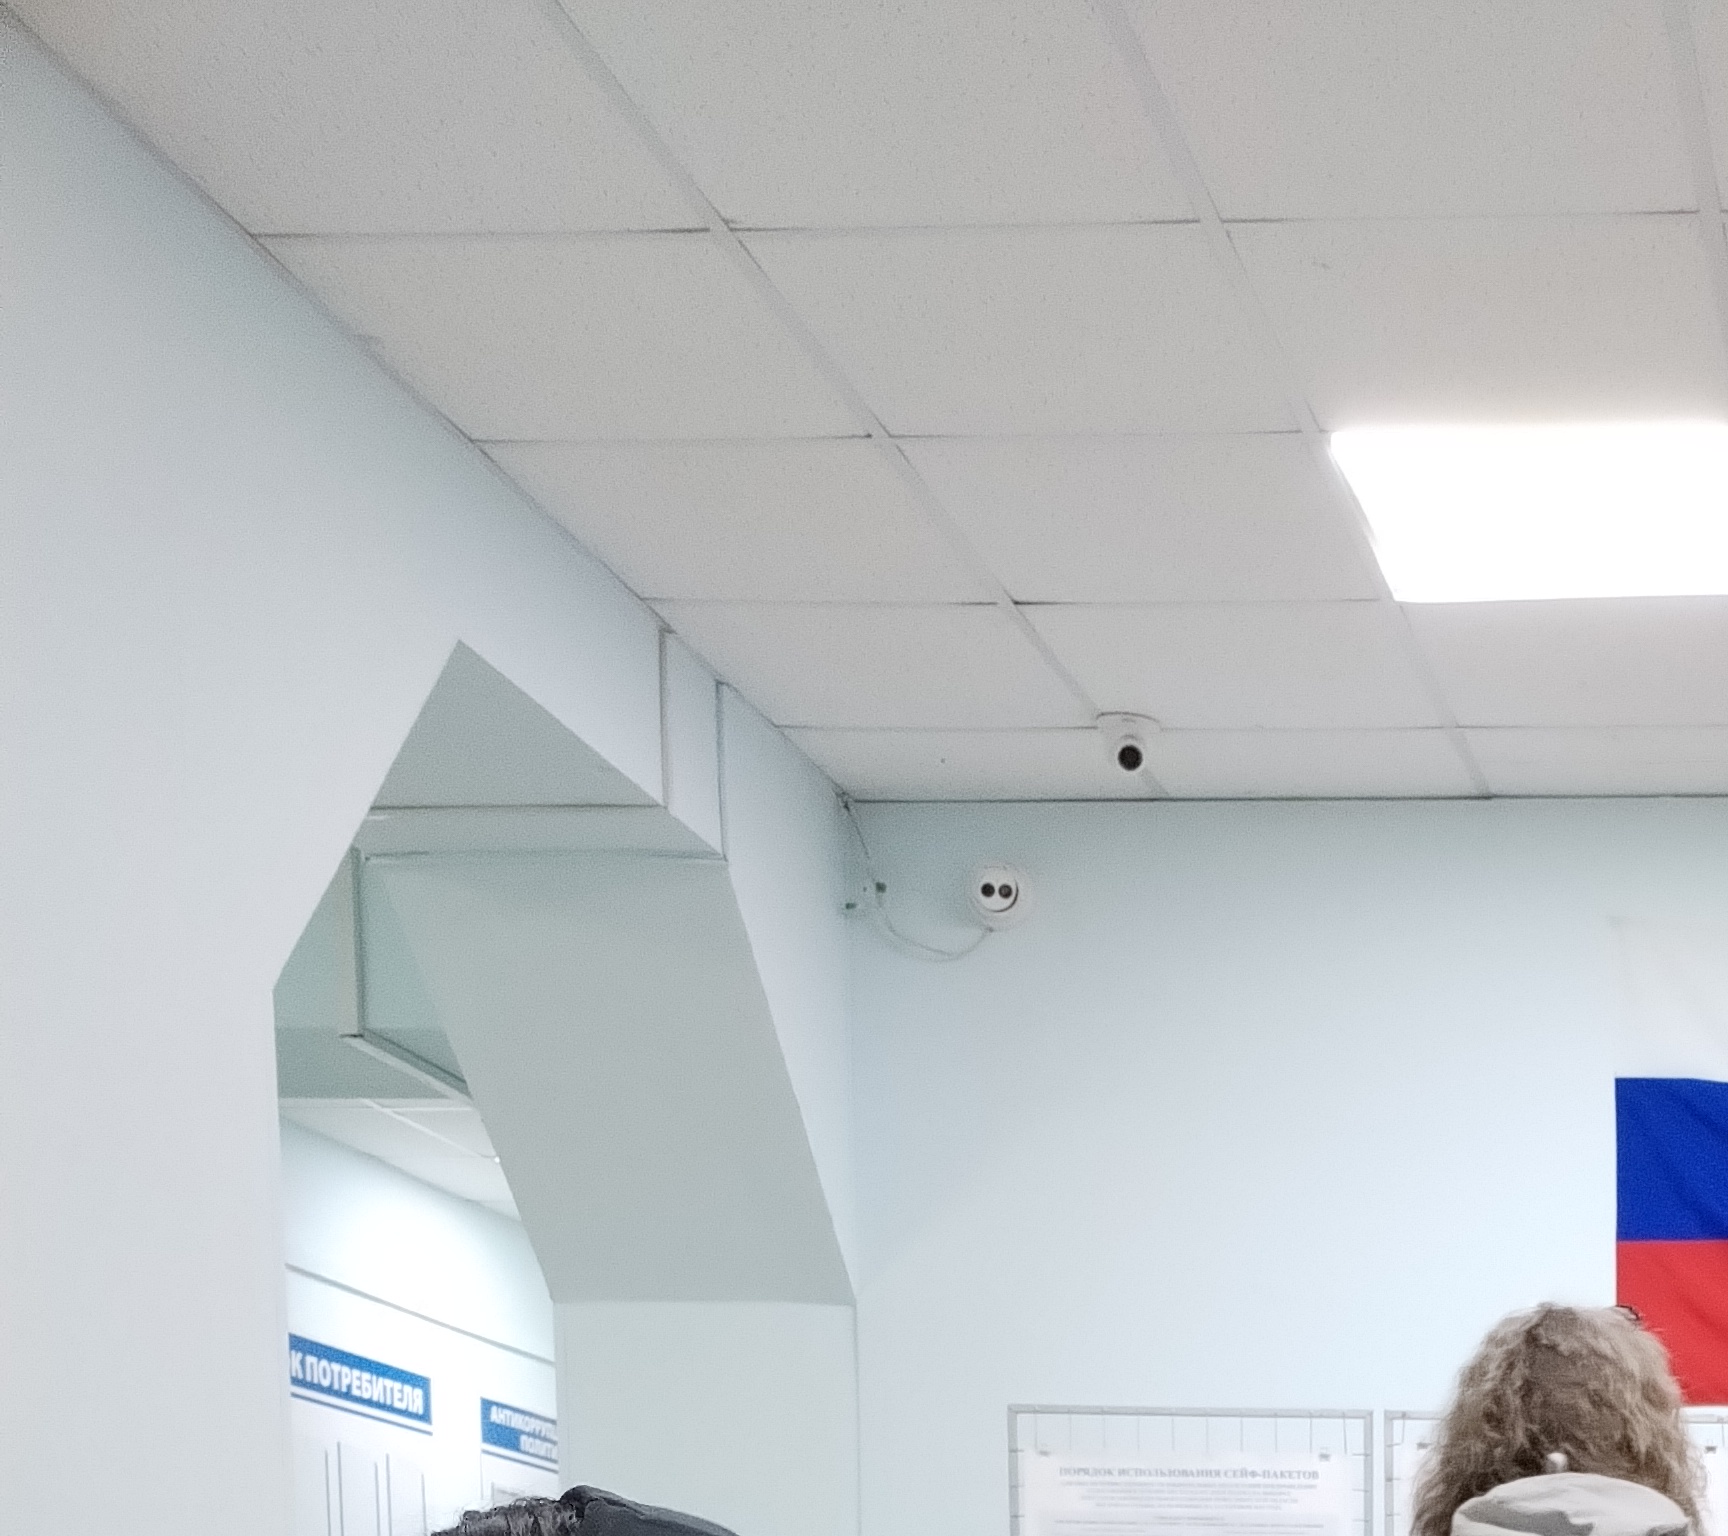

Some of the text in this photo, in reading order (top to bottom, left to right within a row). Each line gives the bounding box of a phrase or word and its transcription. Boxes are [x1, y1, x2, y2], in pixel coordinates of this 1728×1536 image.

[305, 1355, 423, 1415] ПОТРЕБИТЕЛЯ
[1059, 1467, 1320, 1481] ПОРЯДОК ИСПОЛЬЗОВАНИЯ СЕЙФ-ПАКЕТОВ
